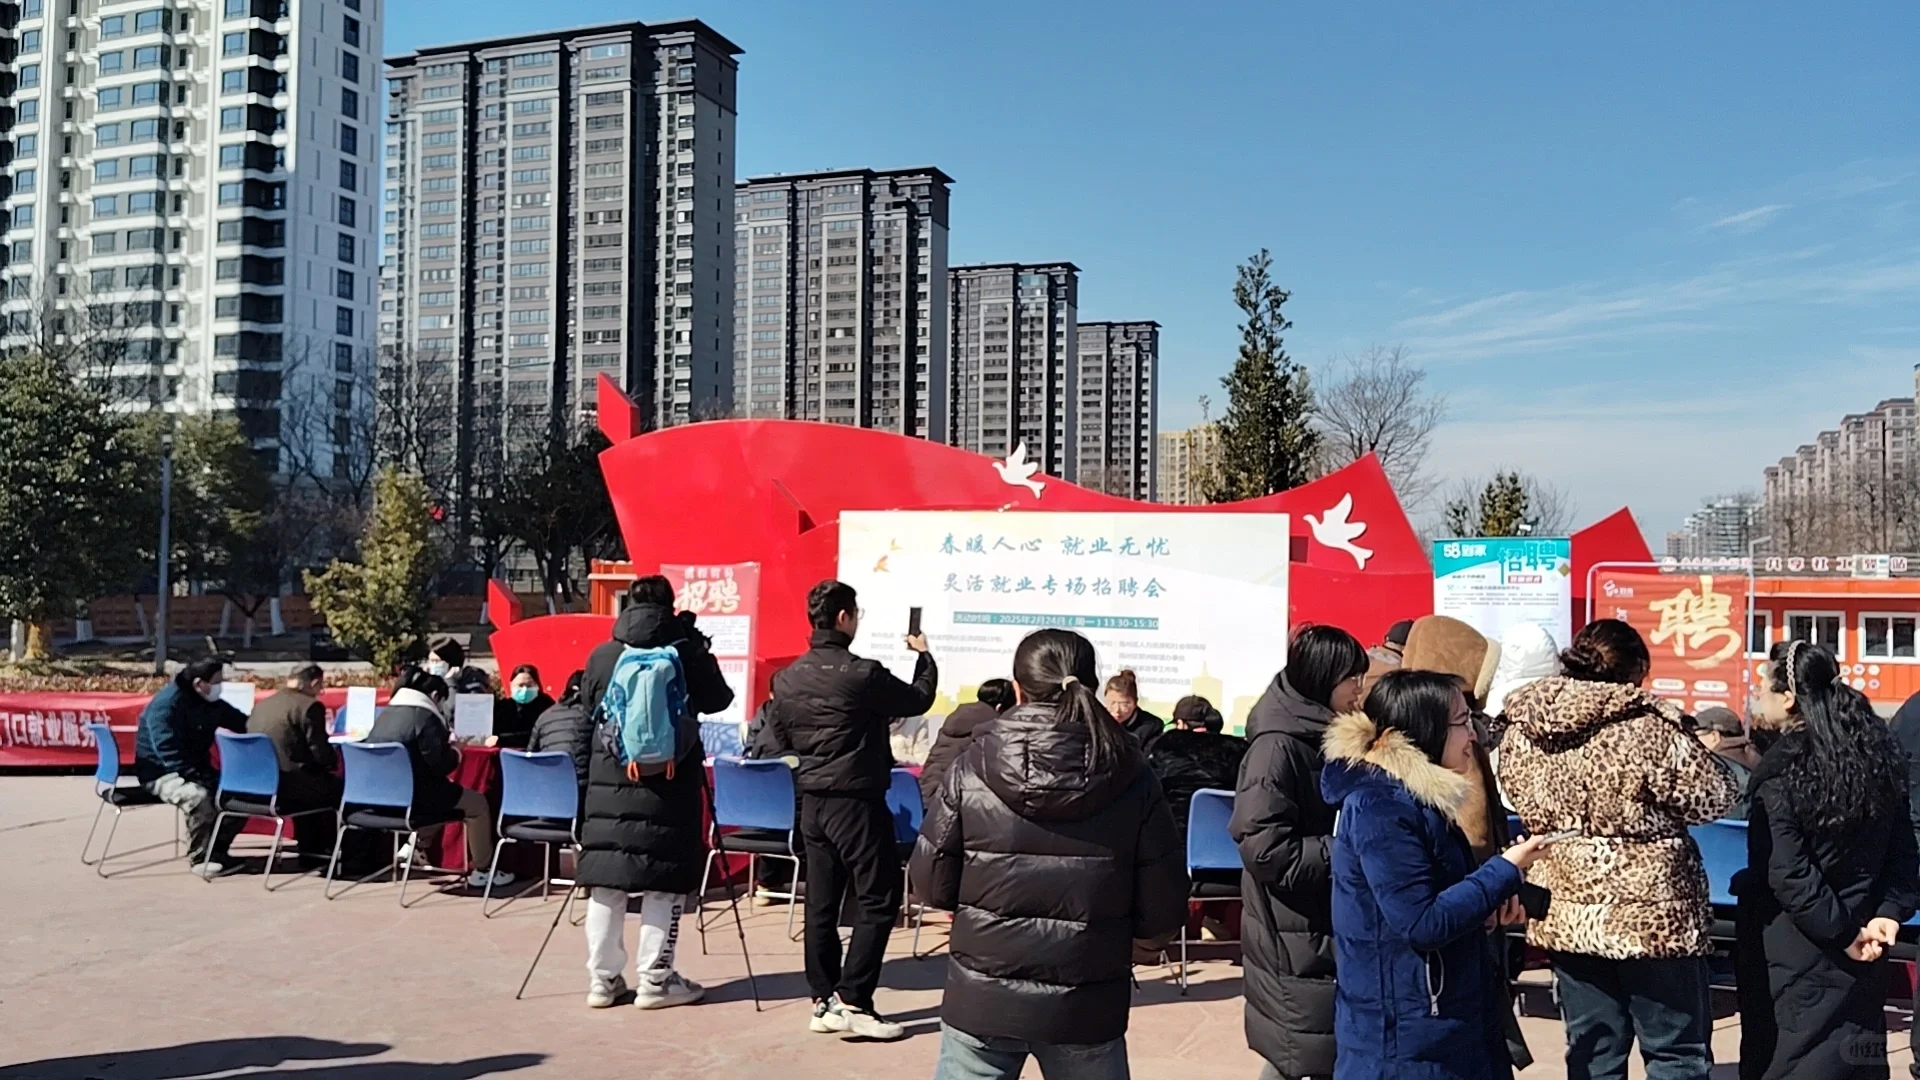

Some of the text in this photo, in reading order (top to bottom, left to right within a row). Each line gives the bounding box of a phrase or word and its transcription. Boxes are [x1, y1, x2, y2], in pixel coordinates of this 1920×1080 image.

[939, 533, 1170, 557] 春暖人心 就业无忧
[1498, 541, 1558, 584] 招聘
[673, 578, 741, 613] 招聘
[943, 572, 1168, 598] 灵活就业专场招聘会
[1649, 575, 1742, 670] 聘
